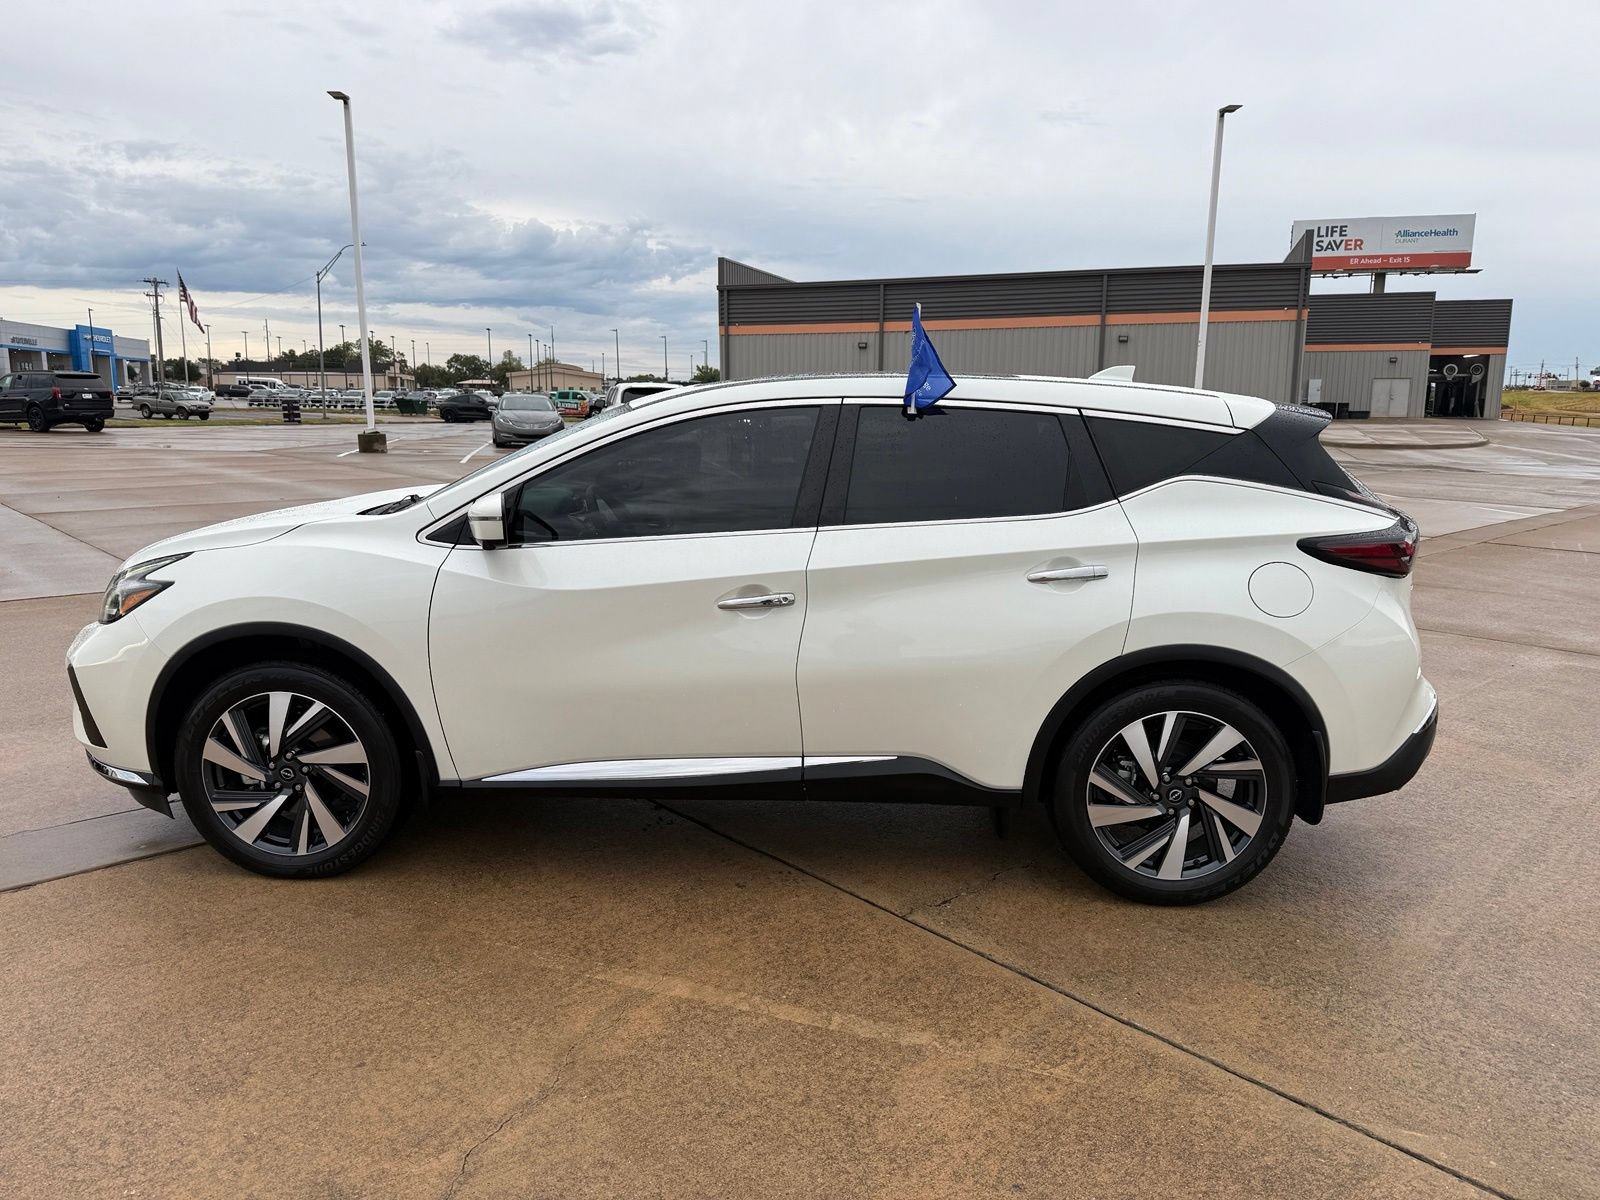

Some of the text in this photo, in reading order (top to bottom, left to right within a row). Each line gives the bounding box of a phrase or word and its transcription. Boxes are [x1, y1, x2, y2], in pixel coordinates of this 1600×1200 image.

[1316, 225, 1348, 238] LIFE
[1395, 228, 1458, 238] AllianceHealth
[1315, 239, 1364, 252] SAVER
